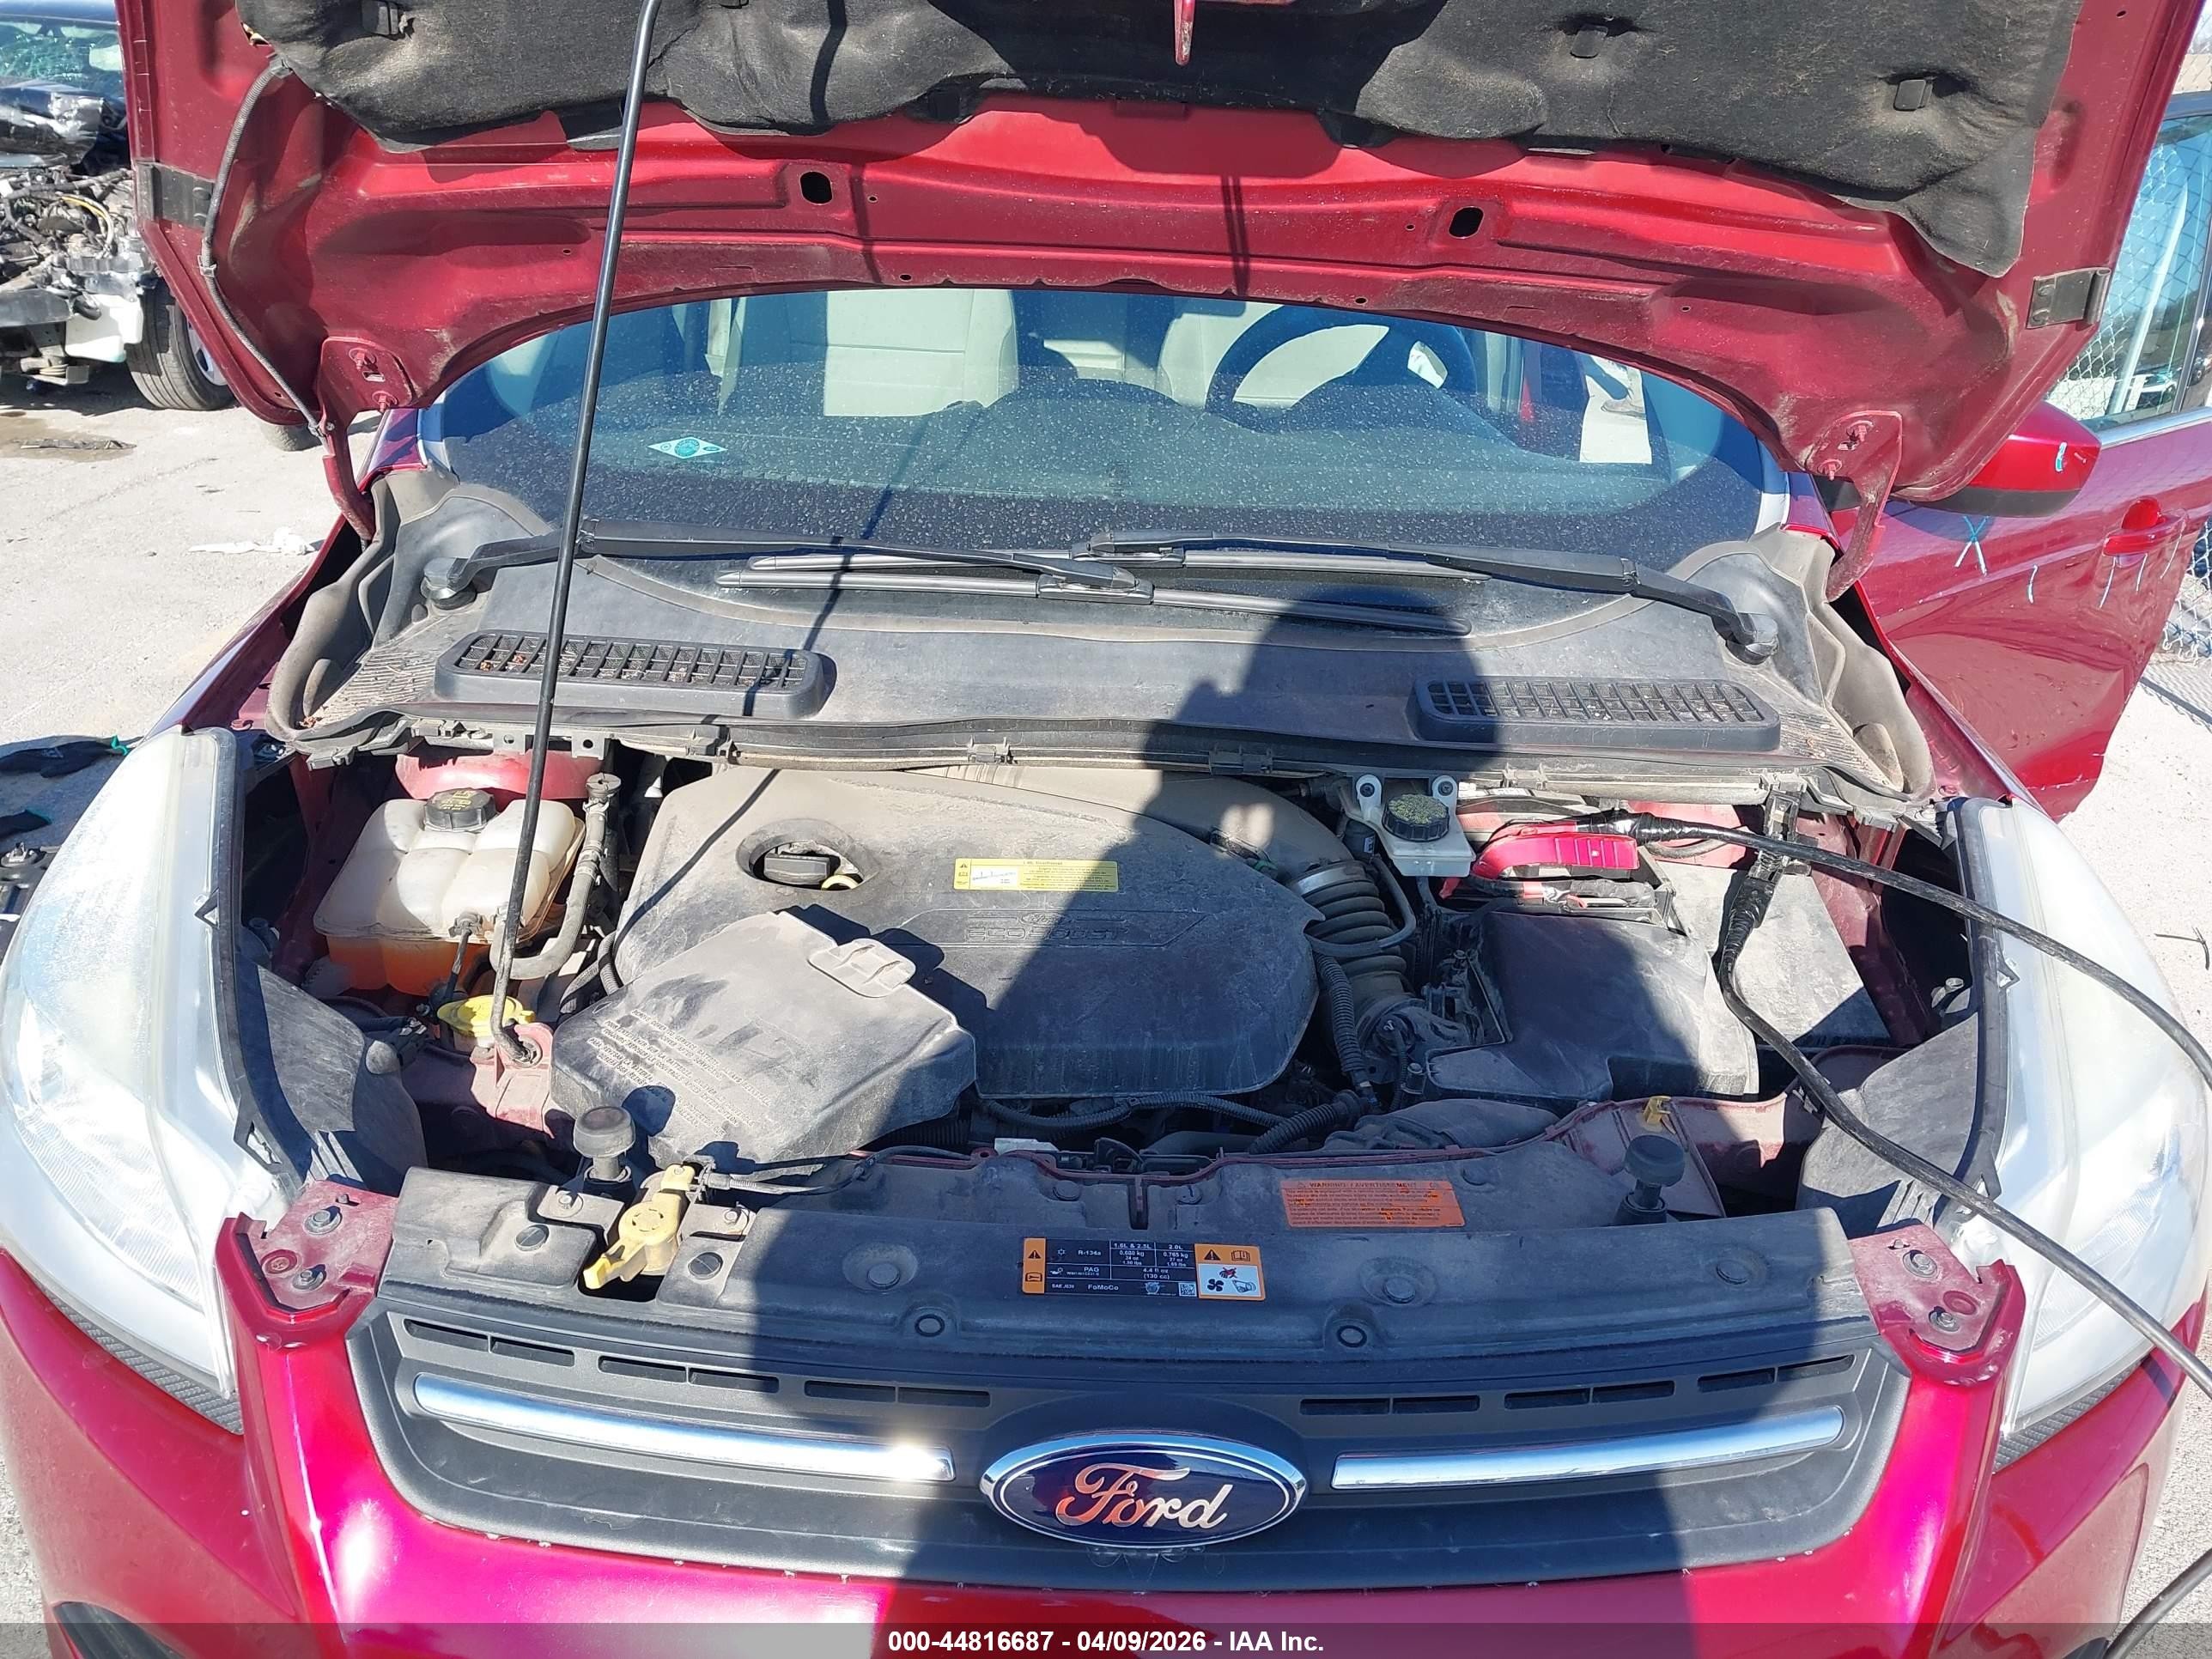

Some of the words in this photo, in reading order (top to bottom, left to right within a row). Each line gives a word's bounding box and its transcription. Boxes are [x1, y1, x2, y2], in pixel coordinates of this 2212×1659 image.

[649, 1019, 667, 1030] COVER
[673, 1035, 696, 1050] SERVICE
[677, 1046, 694, 1058] AFTER
[1055, 1463, 1233, 1529] Ford
